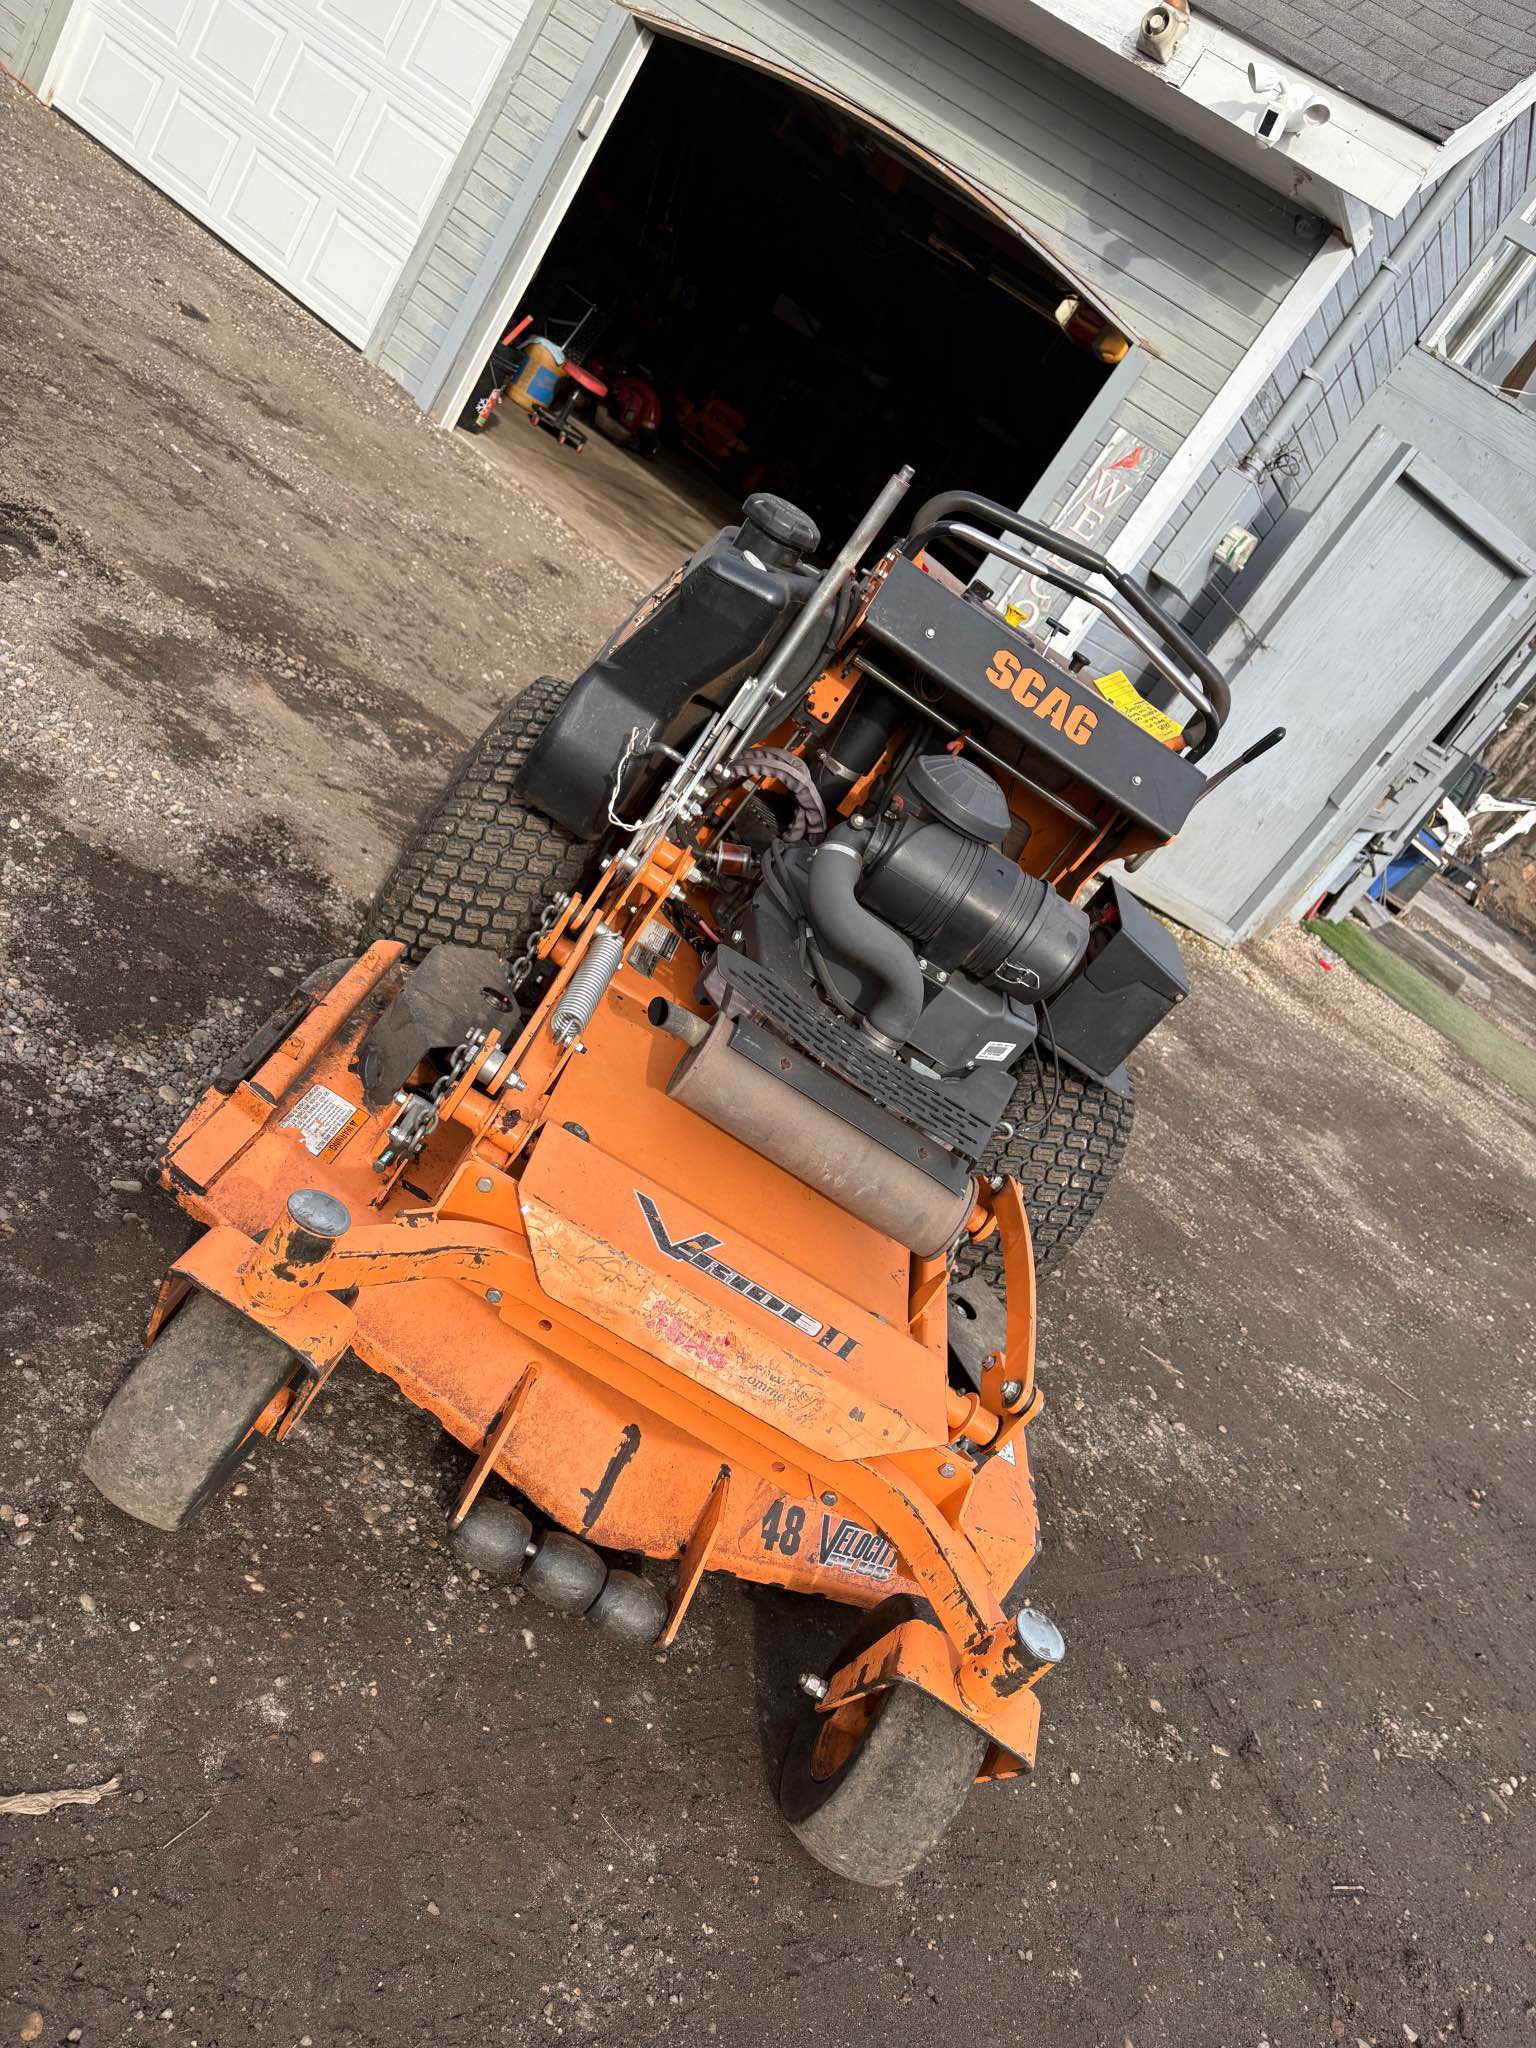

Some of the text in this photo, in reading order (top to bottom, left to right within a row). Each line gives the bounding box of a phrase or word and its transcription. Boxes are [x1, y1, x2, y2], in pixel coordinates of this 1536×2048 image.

[984, 648, 1099, 746] SCAG
[326, 1123, 354, 1152] WARNING
[812, 1323, 864, 1364] II
[760, 1498, 806, 1556] 48
[825, 1553, 891, 1580] PLUS
